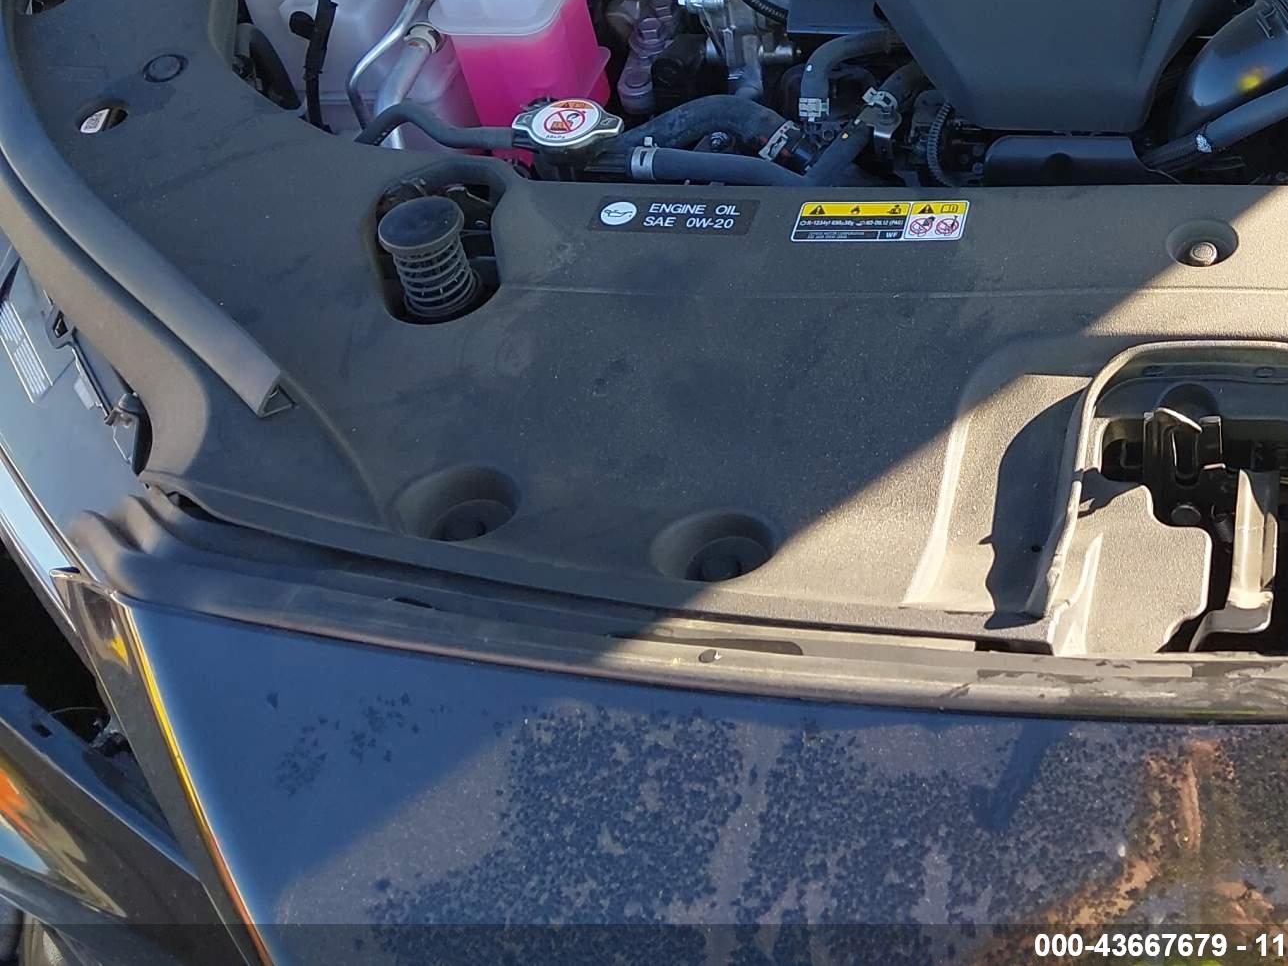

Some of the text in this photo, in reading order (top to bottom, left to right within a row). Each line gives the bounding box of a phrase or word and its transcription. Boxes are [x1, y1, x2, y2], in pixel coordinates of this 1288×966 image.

[649, 203, 741, 216] ENGINE OIL
[643, 216, 734, 229] SAE 0W-20
